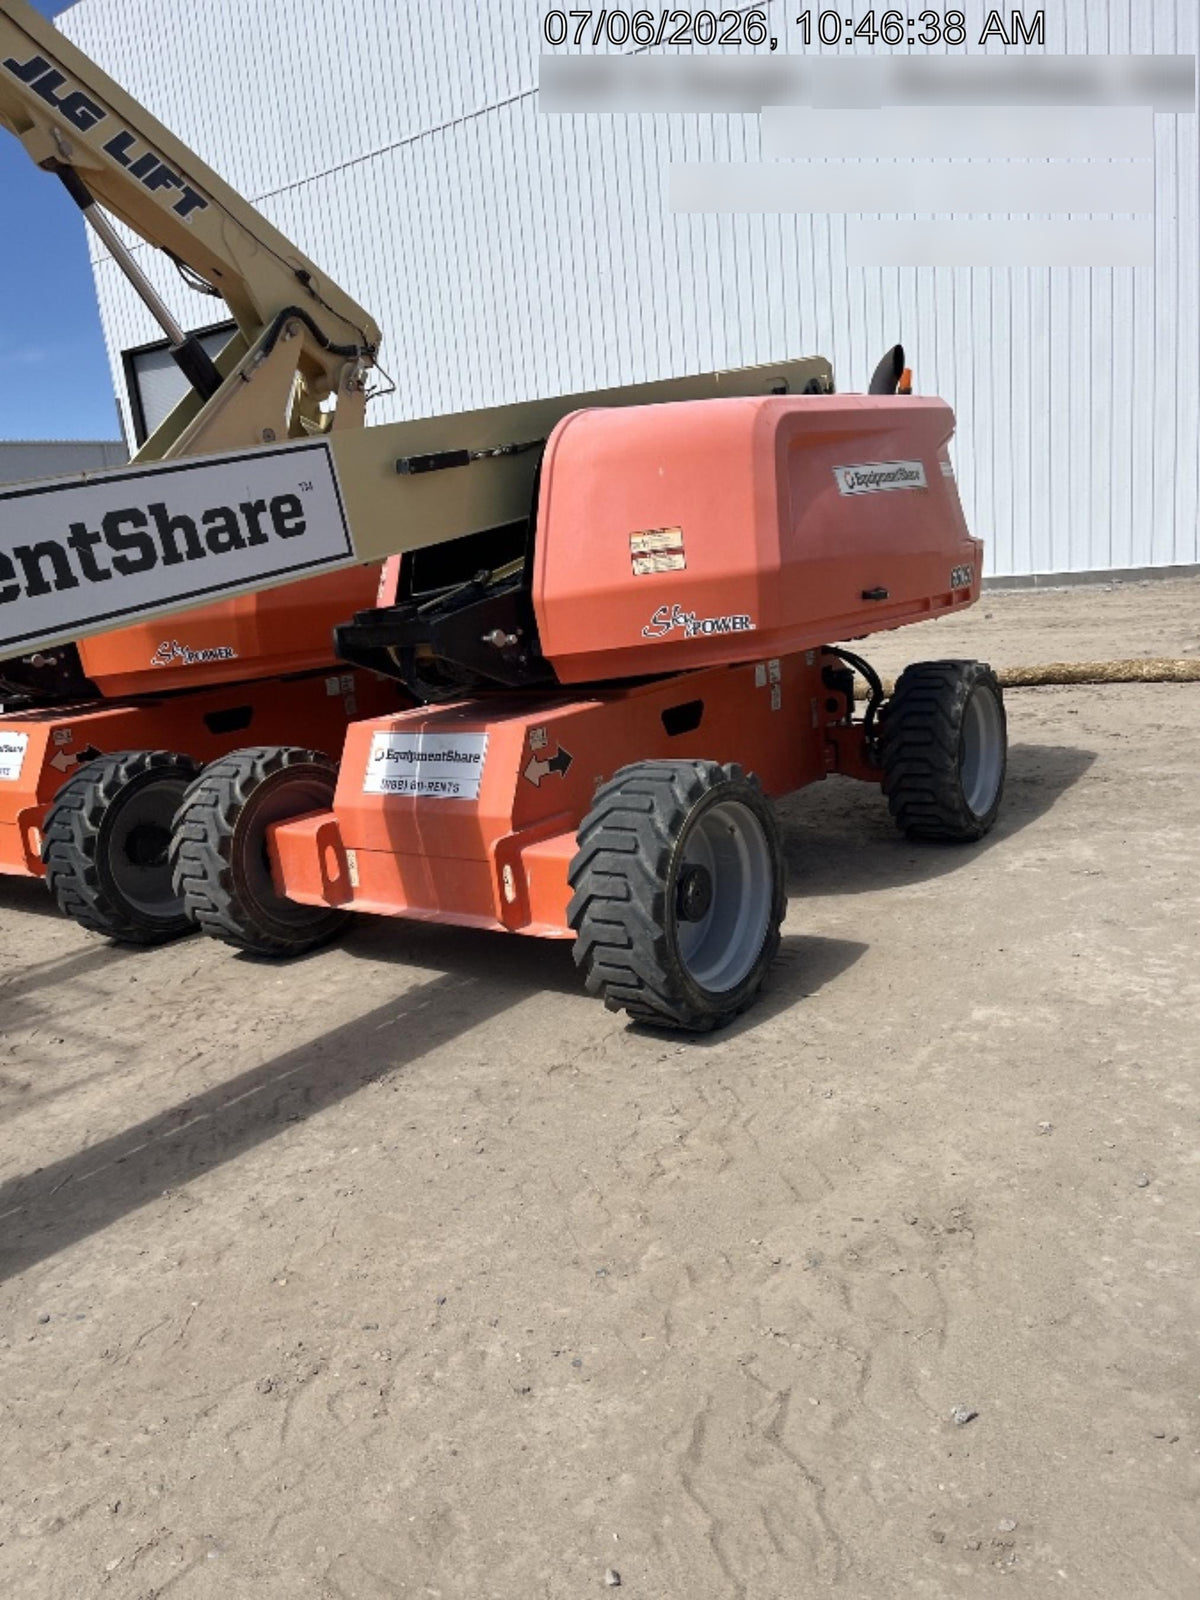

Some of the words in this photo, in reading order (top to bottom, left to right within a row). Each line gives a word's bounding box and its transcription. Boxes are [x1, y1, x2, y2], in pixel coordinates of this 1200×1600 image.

[3, 55, 107, 132] JLG
[103, 130, 209, 218] LIFT
[386, 747, 480, 764] EquipmentShare
